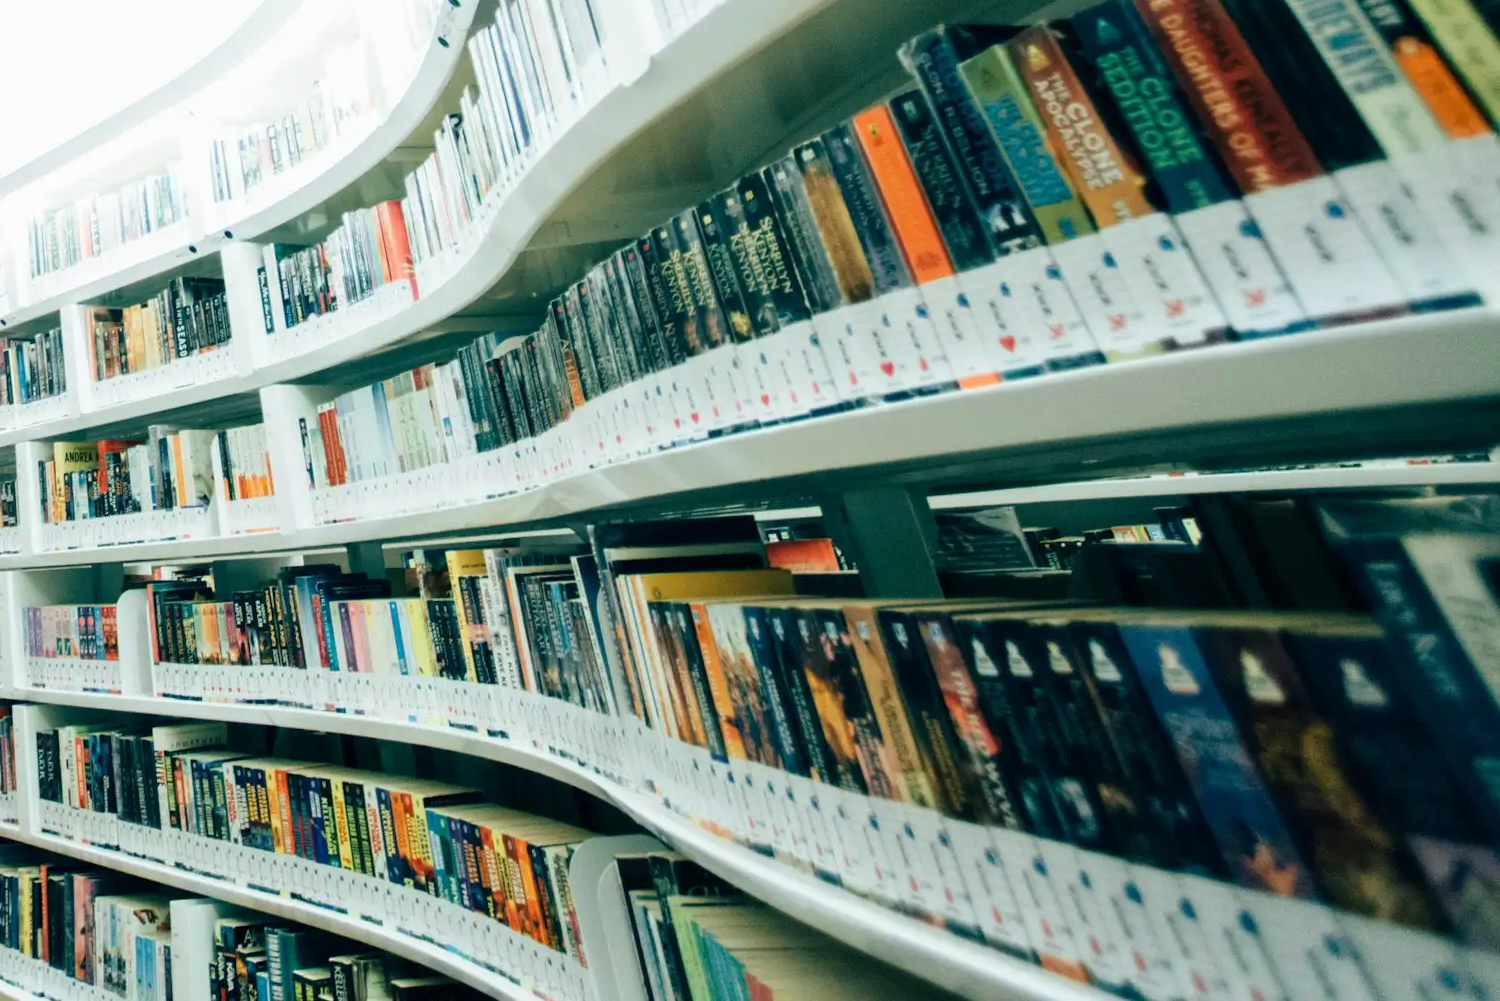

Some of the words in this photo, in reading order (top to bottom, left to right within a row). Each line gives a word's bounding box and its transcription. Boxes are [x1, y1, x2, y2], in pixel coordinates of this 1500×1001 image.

[1093, 51, 1181, 171] SEDITION
[1116, 47, 1147, 76] THE
[1135, 75, 1204, 166] CLONE
[1156, 7, 1241, 132] DAUGHTERS
[1223, 125, 1262, 169] OF
[940, 104, 992, 198] REBELLION
[1028, 78, 1107, 191] APOCALYPSE
[1043, 72, 1073, 100] THE
[1061, 101, 1127, 186] CLONE
[660, 257, 685, 315] KENYON
[670, 247, 699, 317] SHERRILYN
[682, 248, 708, 308] KENYON
[689, 239, 718, 310] SHERRILYN
[706, 241, 735, 300] KENYON
[728, 232, 758, 295] KENYON
[749, 227, 782, 293] KENYON
[758, 214, 796, 296] SHERRILYN
[175, 324, 188, 357] SEASO
[64, 449, 94, 463] ANDREA
[253, 599, 264, 629] KAPLAN
[319, 795, 335, 856] KELLERMAN
[267, 932, 283, 984] JONATHAN
